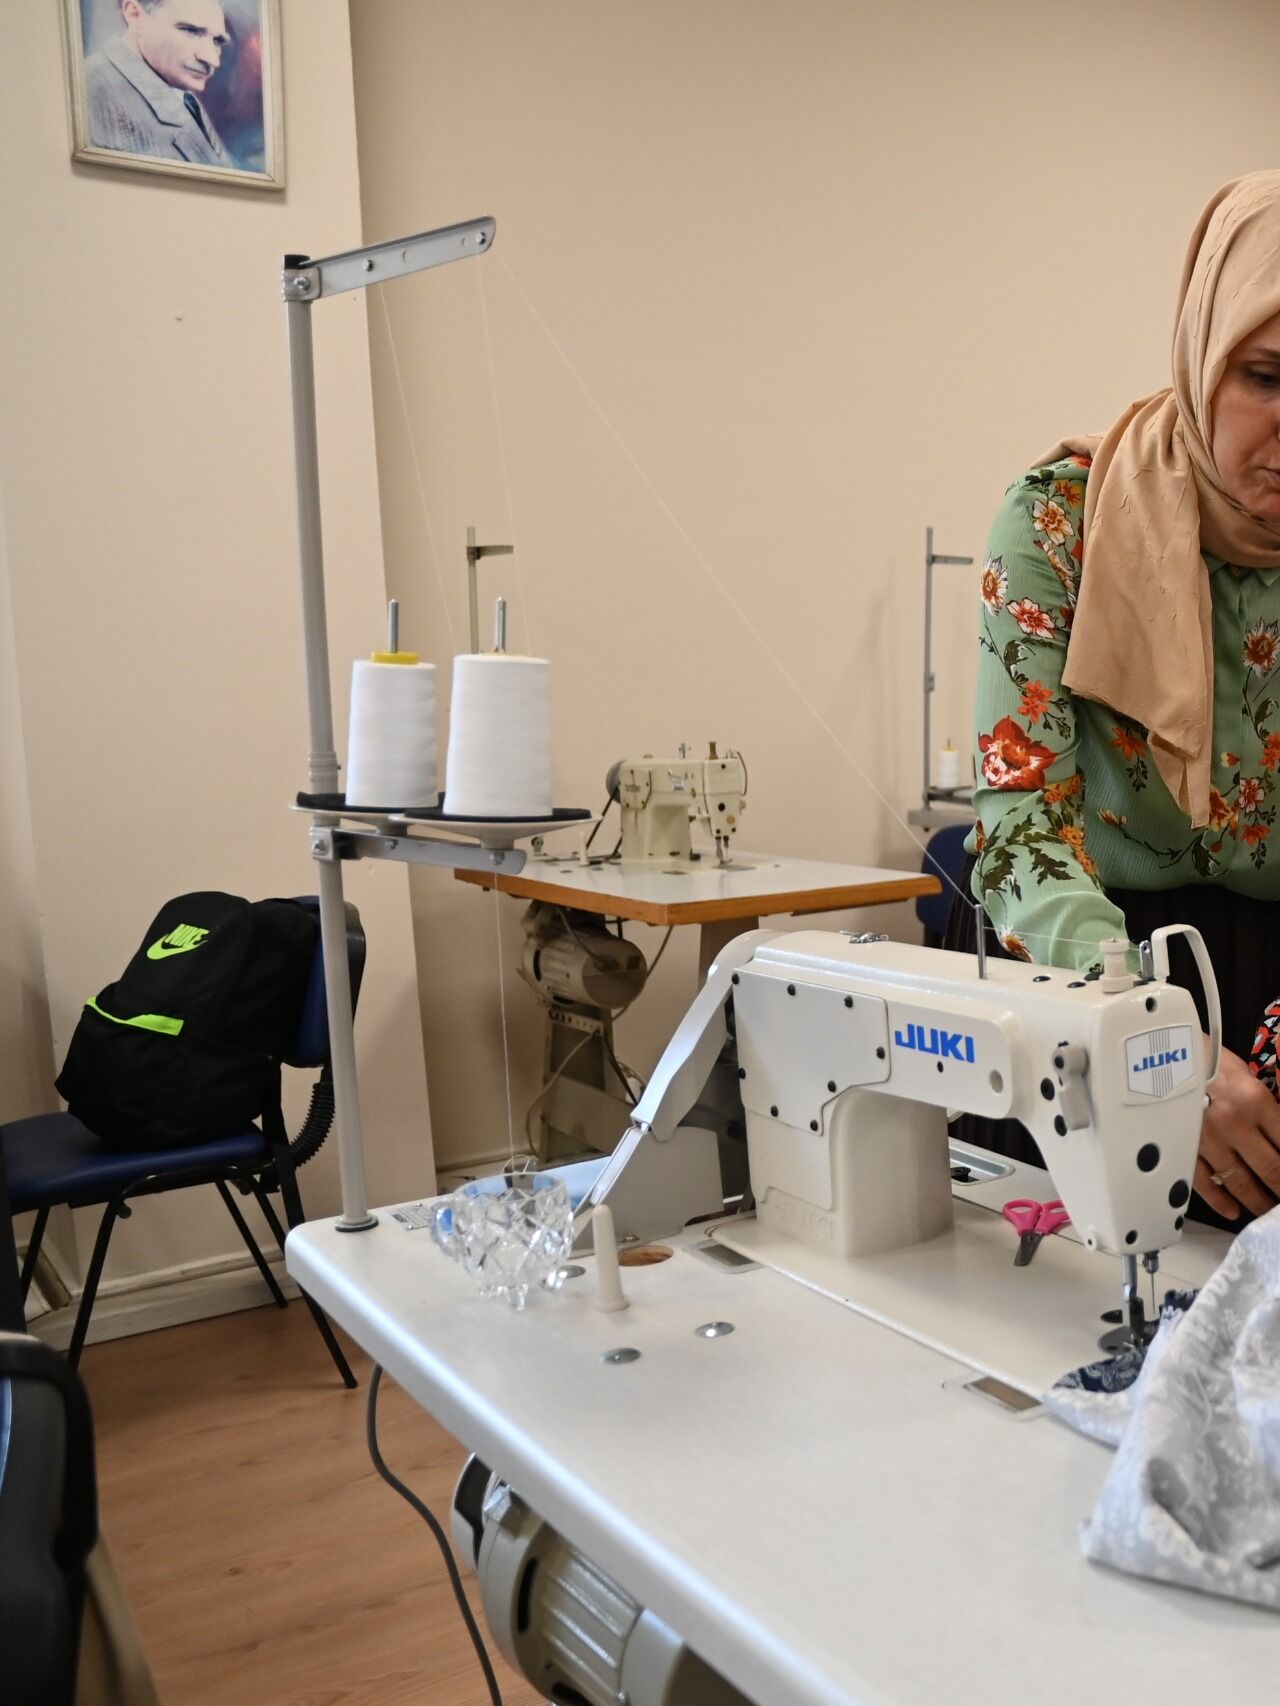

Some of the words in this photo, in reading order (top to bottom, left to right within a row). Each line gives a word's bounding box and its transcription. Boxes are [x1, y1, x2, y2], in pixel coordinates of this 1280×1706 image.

[164, 923, 210, 946] NIKE
[895, 1023, 975, 1063] JUKI
[1133, 1048, 1187, 1072] JUKI
